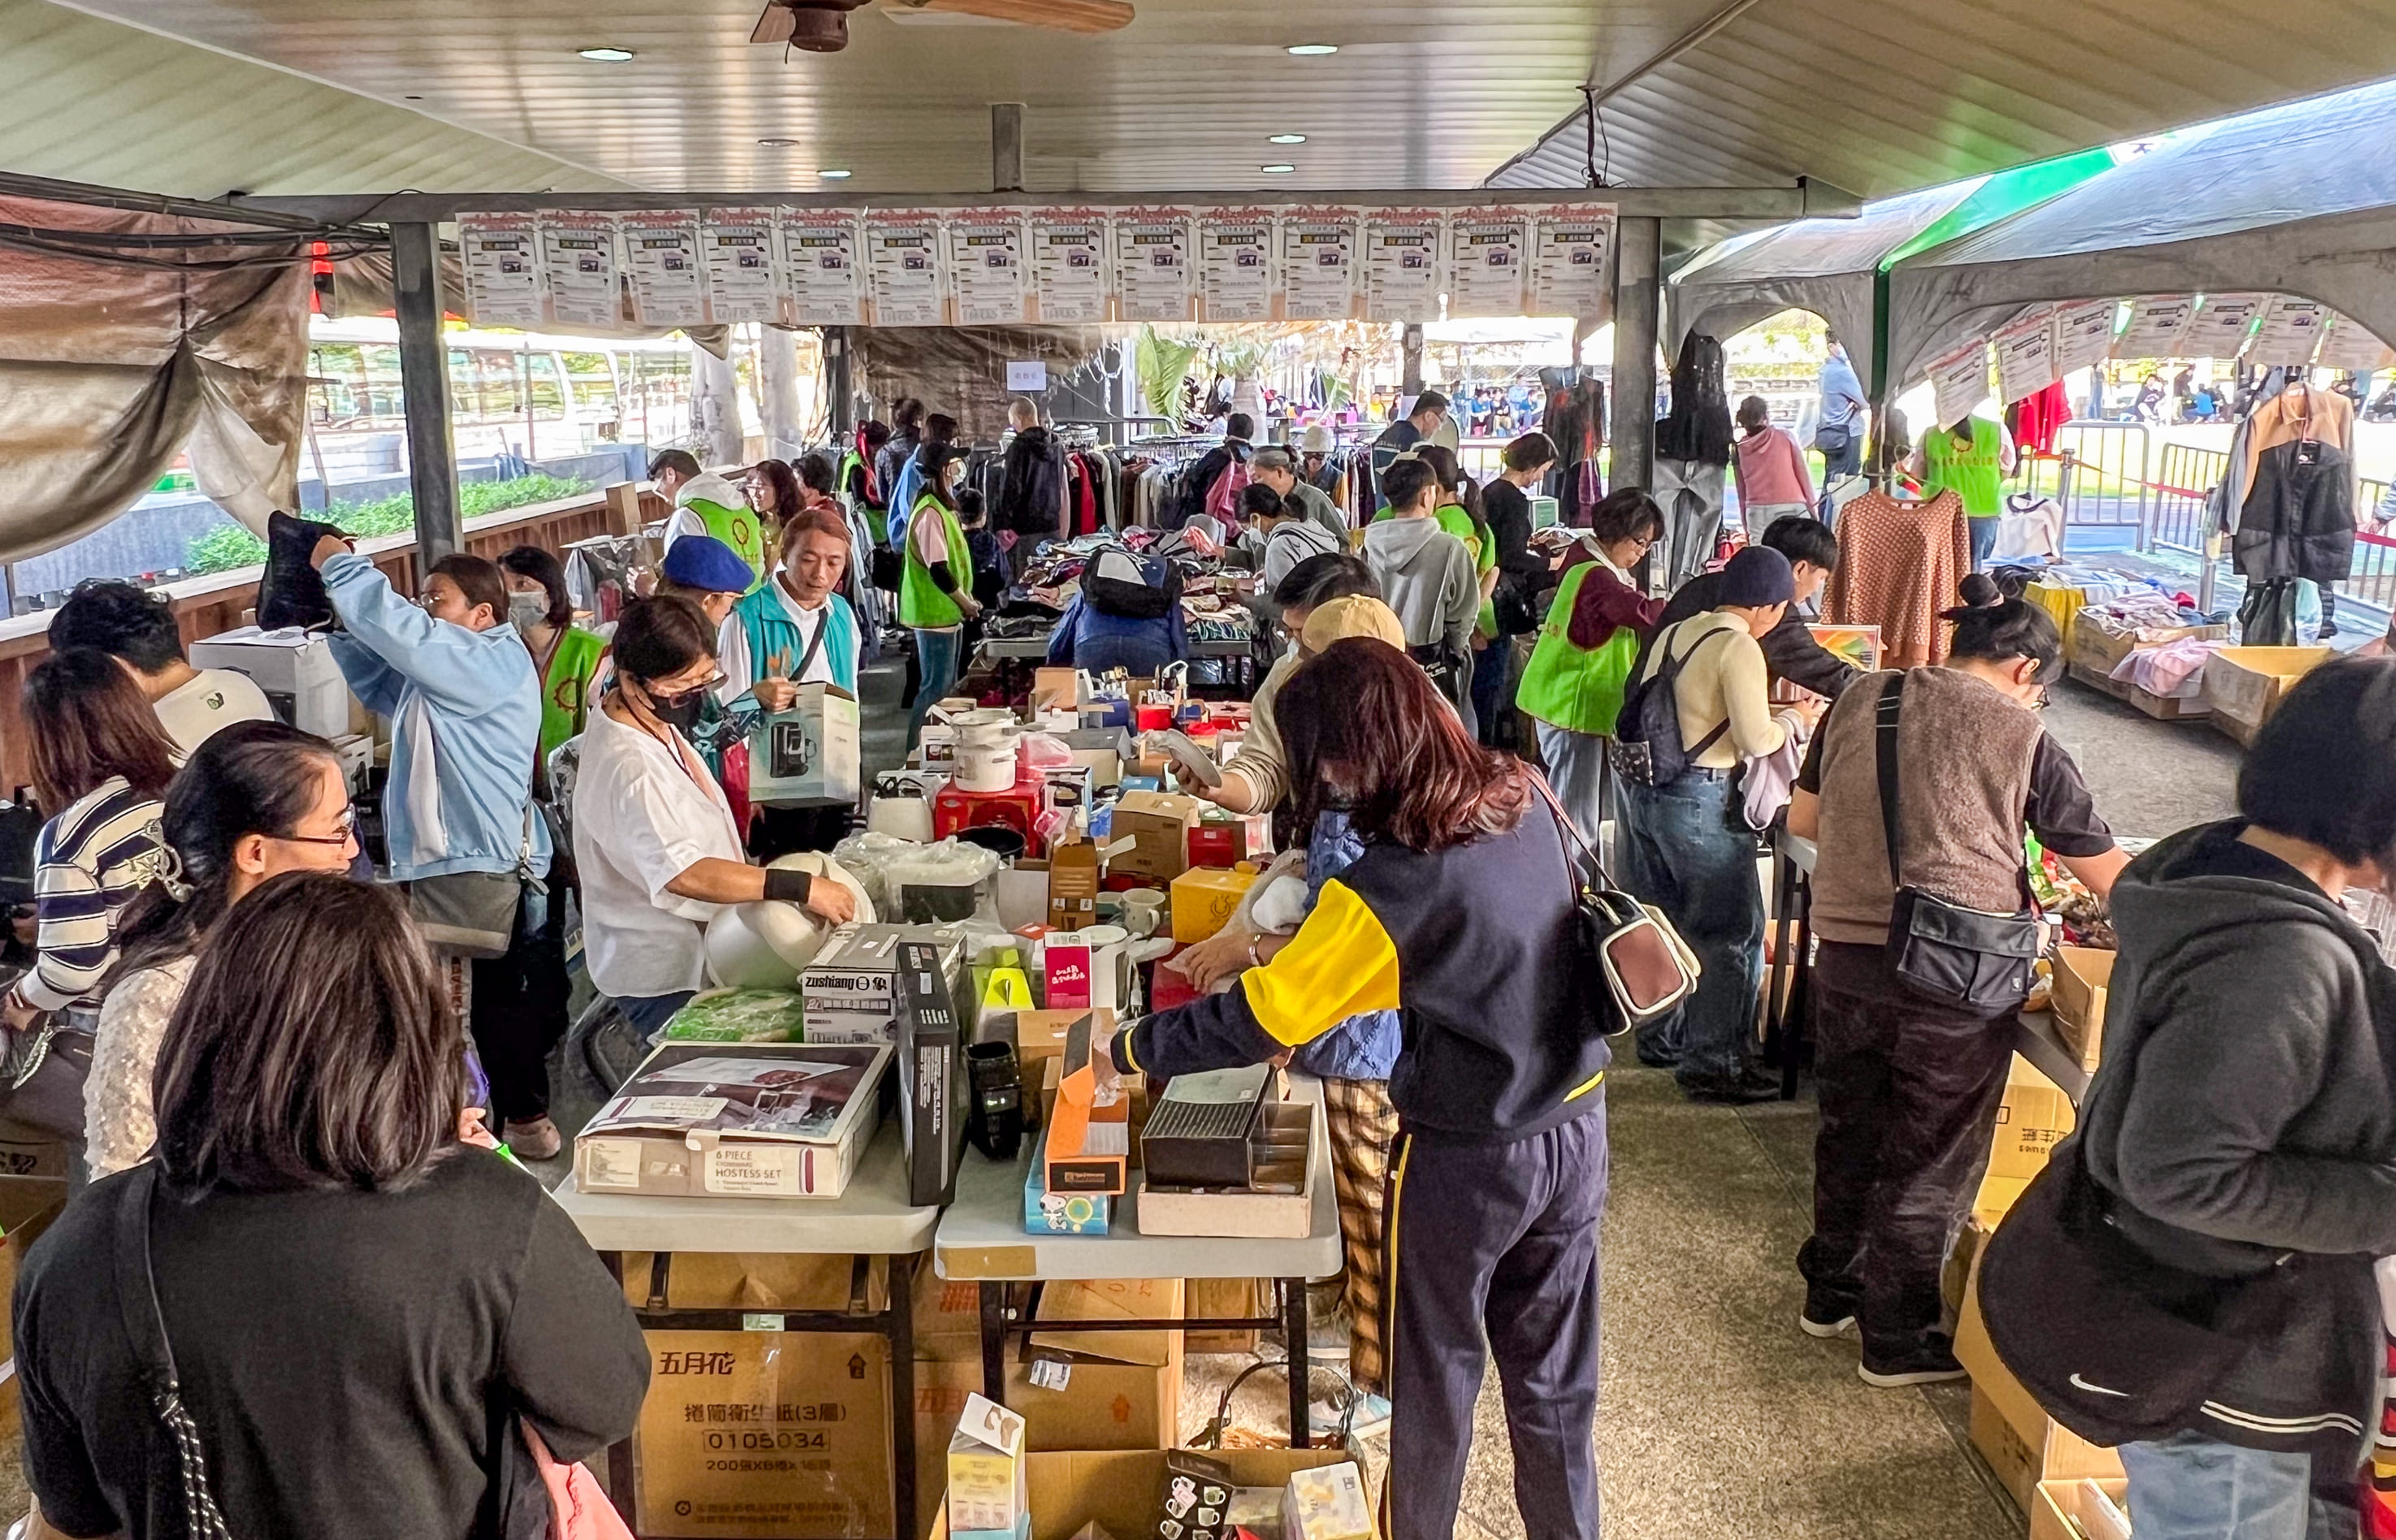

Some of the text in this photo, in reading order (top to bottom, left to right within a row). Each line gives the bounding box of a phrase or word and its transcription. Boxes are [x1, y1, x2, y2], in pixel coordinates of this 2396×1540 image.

[725, 1150, 752, 1161] PIECE
[716, 1169, 782, 1179] HOSTESS SET
[658, 1352, 736, 1374] 五月花
[709, 1433, 824, 1449] 0105034
